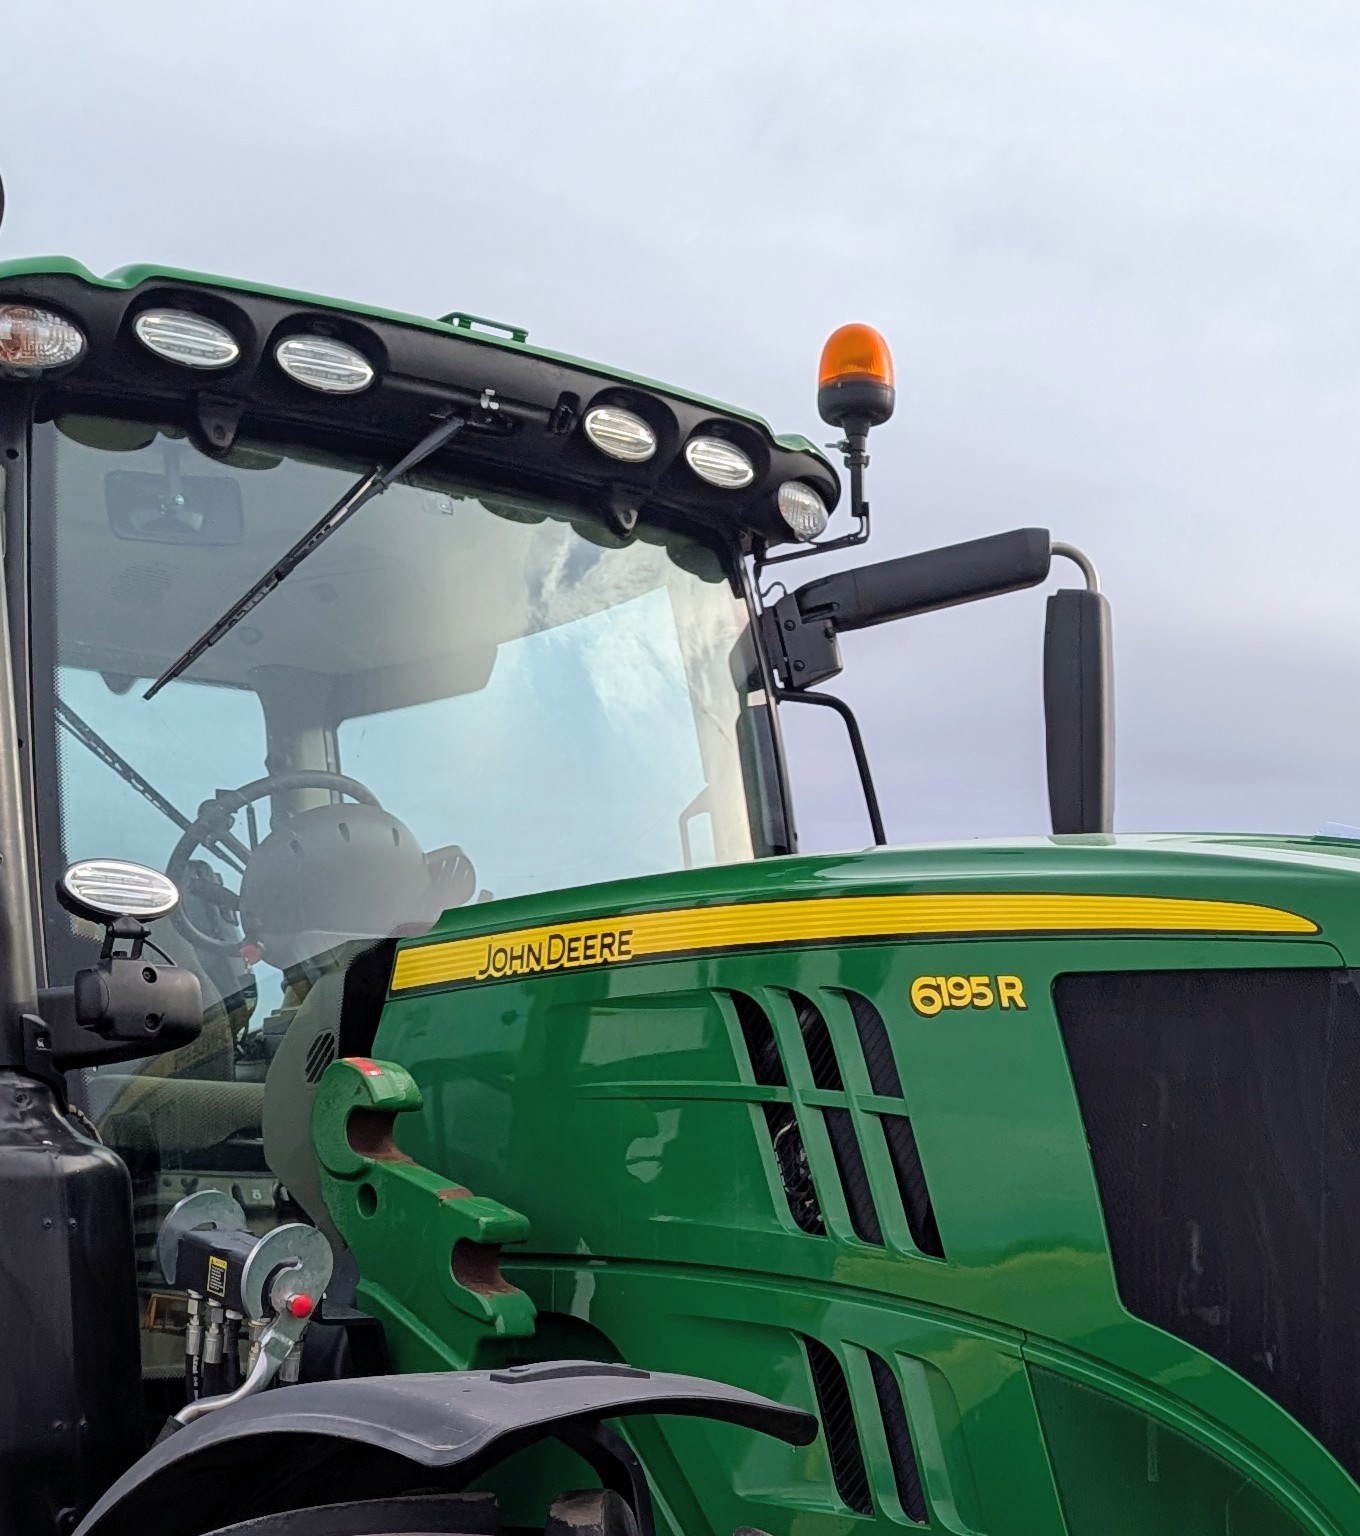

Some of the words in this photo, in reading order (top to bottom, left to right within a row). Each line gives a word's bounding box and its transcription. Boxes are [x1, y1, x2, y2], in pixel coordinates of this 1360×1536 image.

[478, 941, 543, 977] JOHN
[546, 932, 634, 967] DEERE
[909, 974, 994, 1018] 6195
[996, 974, 1028, 1011] R
